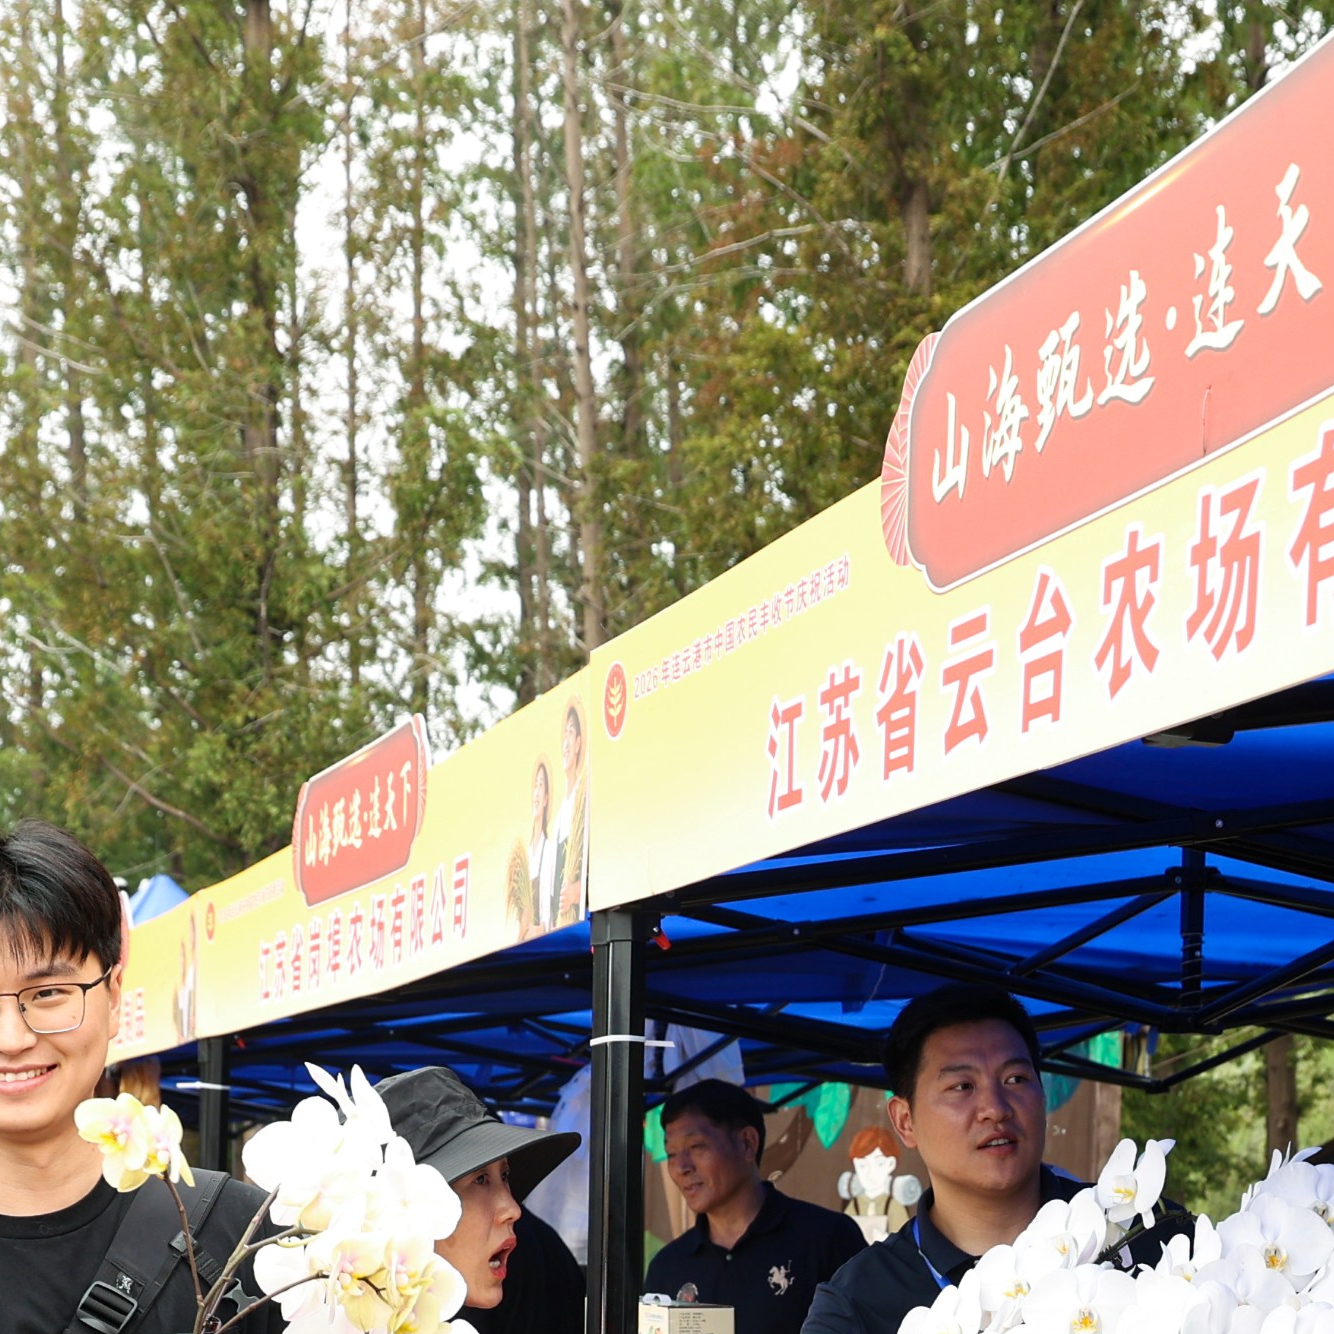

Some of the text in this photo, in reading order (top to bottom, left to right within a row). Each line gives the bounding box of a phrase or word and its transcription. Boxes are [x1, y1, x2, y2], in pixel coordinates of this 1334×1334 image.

[259, 857, 469, 1000] 江苏省岗埠农场有限公司
